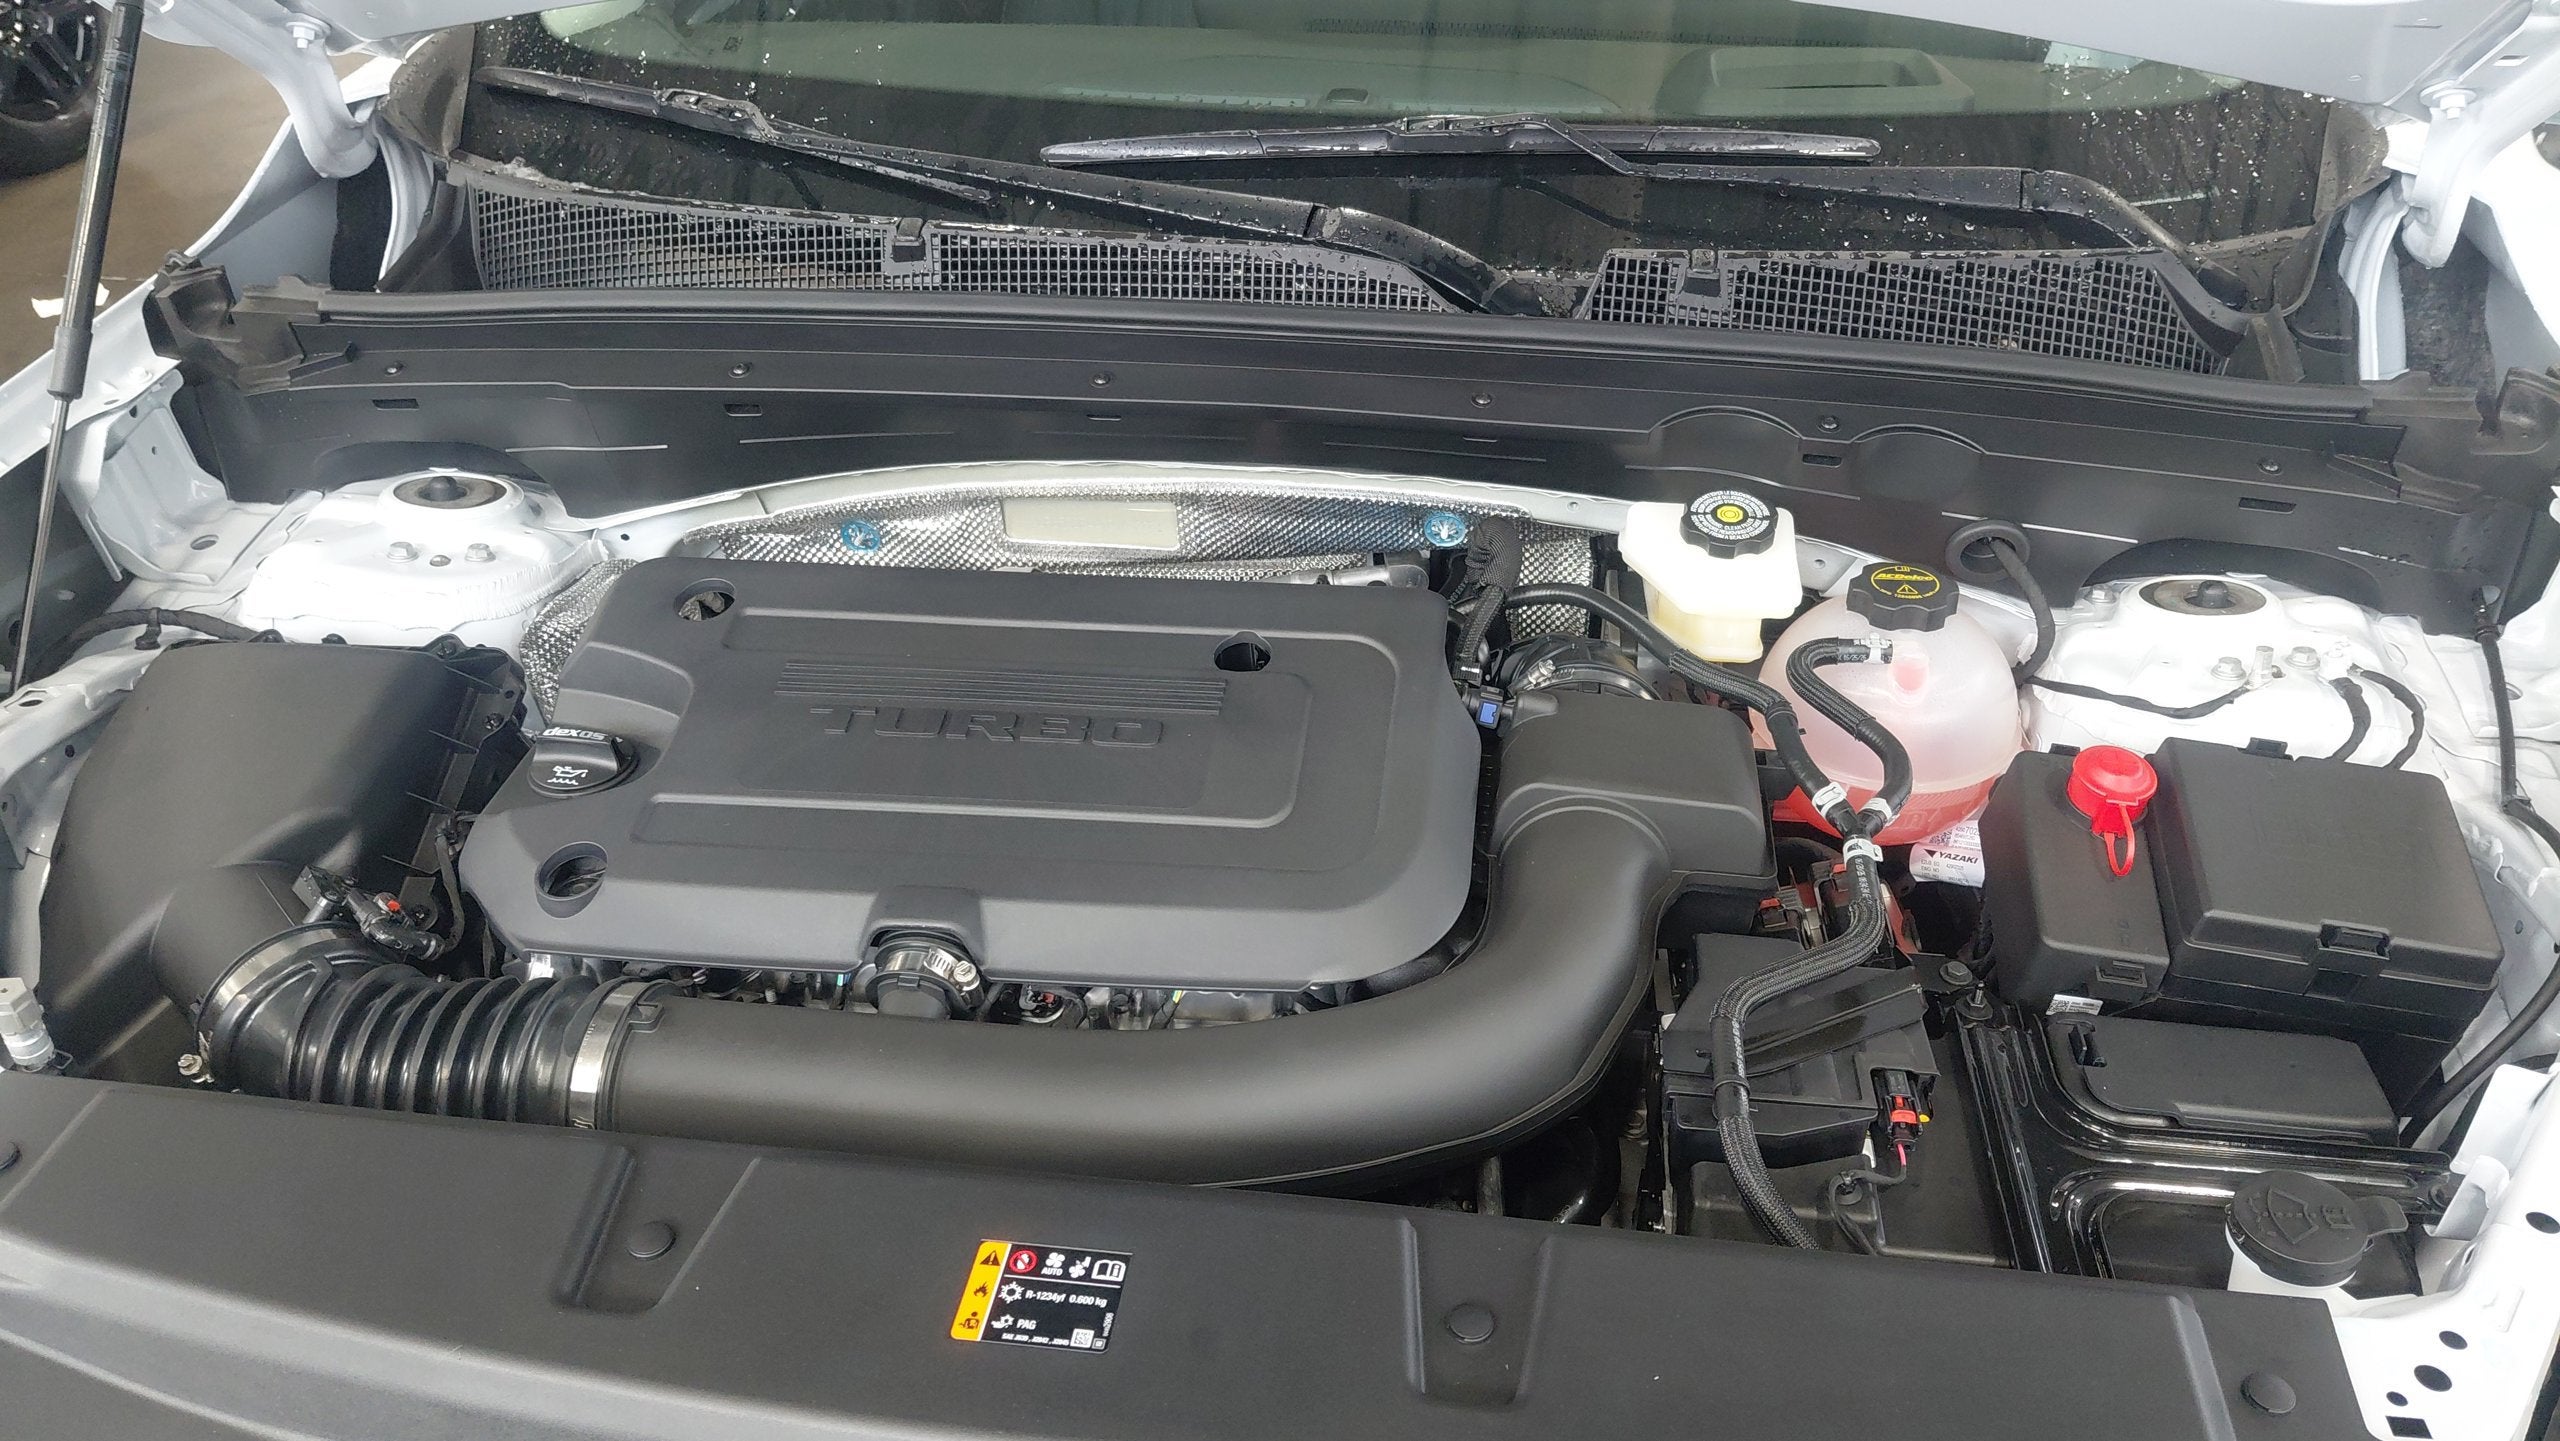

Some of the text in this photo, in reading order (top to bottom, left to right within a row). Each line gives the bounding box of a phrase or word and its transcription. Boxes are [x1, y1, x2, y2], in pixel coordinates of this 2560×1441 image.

[1874, 573, 1934, 581] ACDelco
[542, 726, 609, 741] dexos
[809, 706, 1164, 748] TURBO
[1939, 851, 1979, 864] YAZAKI
[1041, 1266, 1063, 1276] AUTO
[1025, 1289, 1108, 1308] R-1234yf 0.600 kg
[1016, 1318, 1037, 1330] PAG
